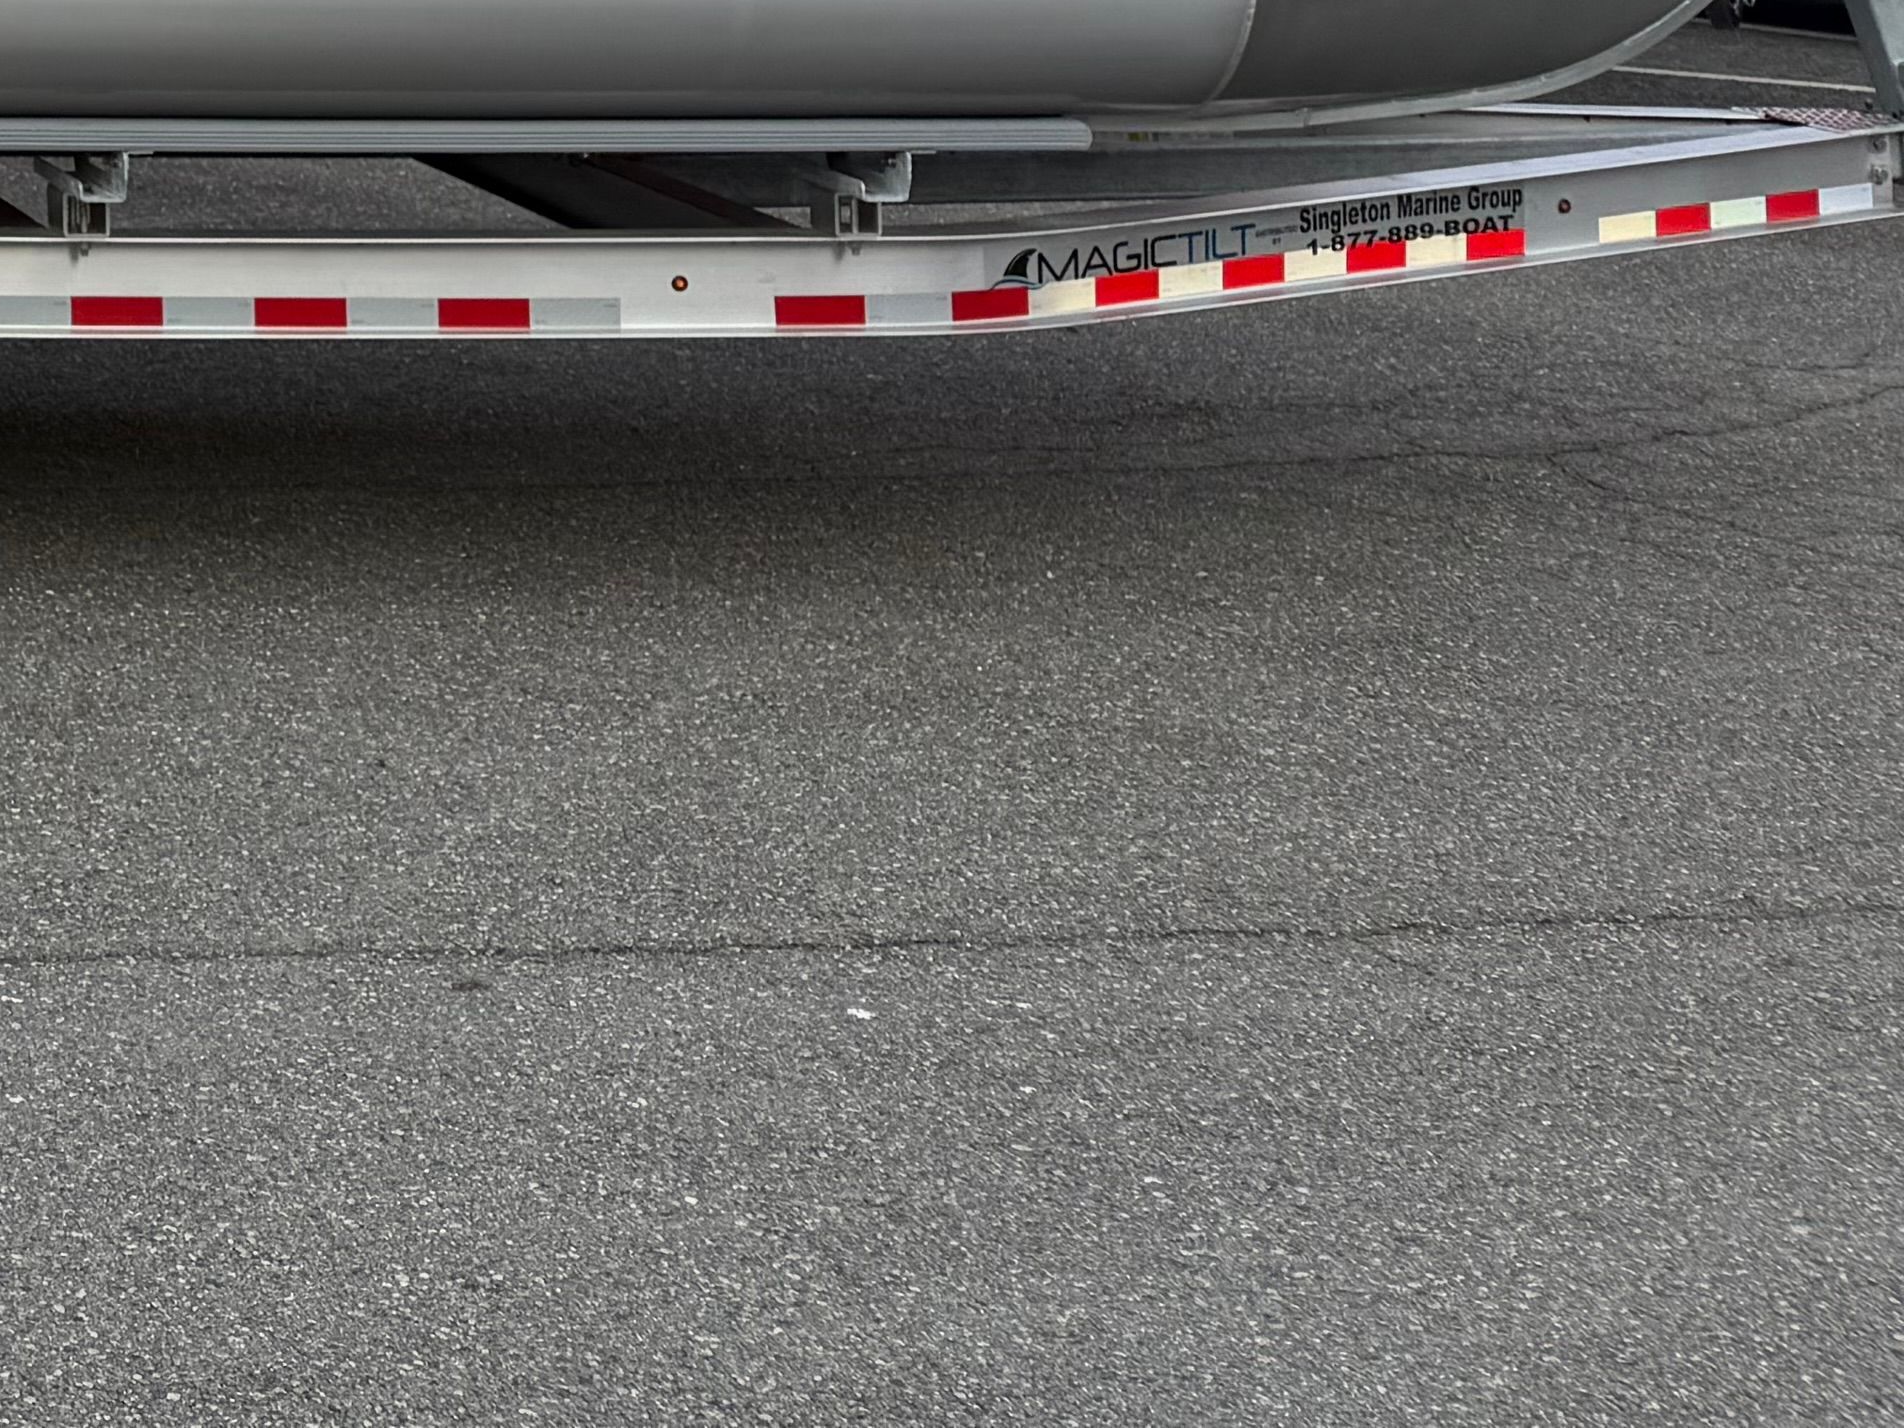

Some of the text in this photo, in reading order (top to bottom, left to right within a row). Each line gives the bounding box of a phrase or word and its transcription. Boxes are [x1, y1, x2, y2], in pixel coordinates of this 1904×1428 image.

[1299, 200, 1391, 234] Singleton
[1397, 190, 1462, 219] Marine
[1466, 185, 1523, 213] Group
[1037, 222, 1256, 284] MAGICTILT
[1306, 214, 1515, 256] 1-877-889-BOAT
